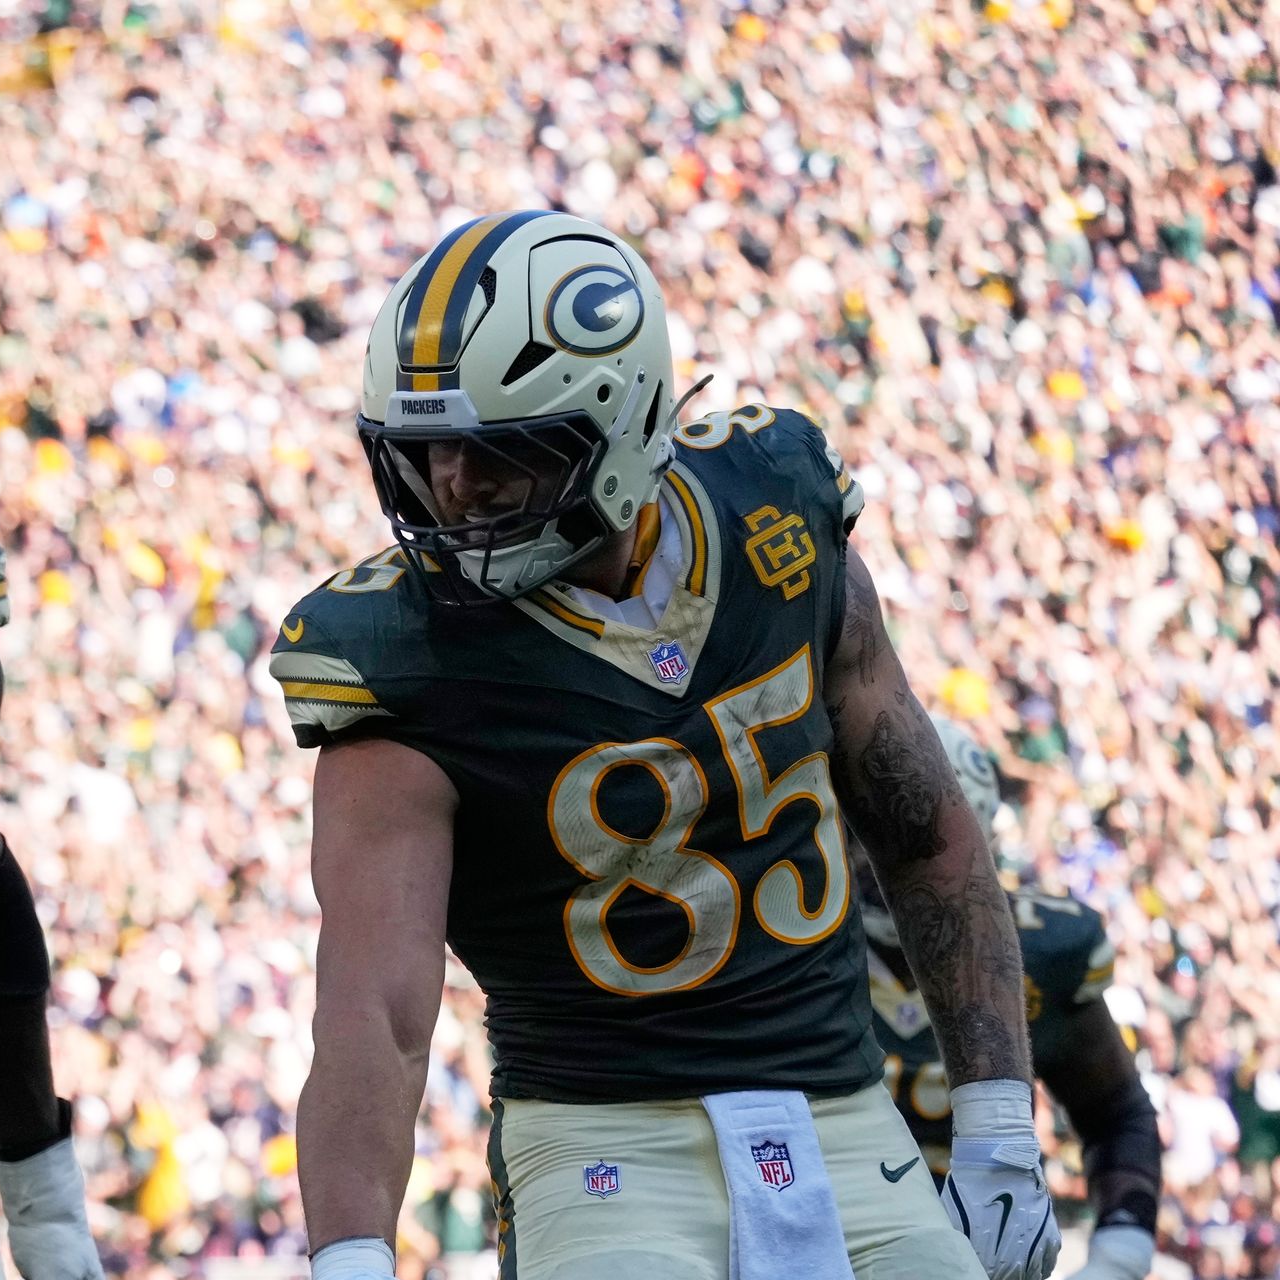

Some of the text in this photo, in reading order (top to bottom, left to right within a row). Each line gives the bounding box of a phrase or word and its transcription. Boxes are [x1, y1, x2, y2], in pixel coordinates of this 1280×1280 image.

[401, 399, 446, 415] PACKERS
[659, 656, 685, 678] NFL
[548, 643, 850, 997] 85
[590, 1176, 616, 1191] NFL
[758, 1161, 792, 1187] NFL
